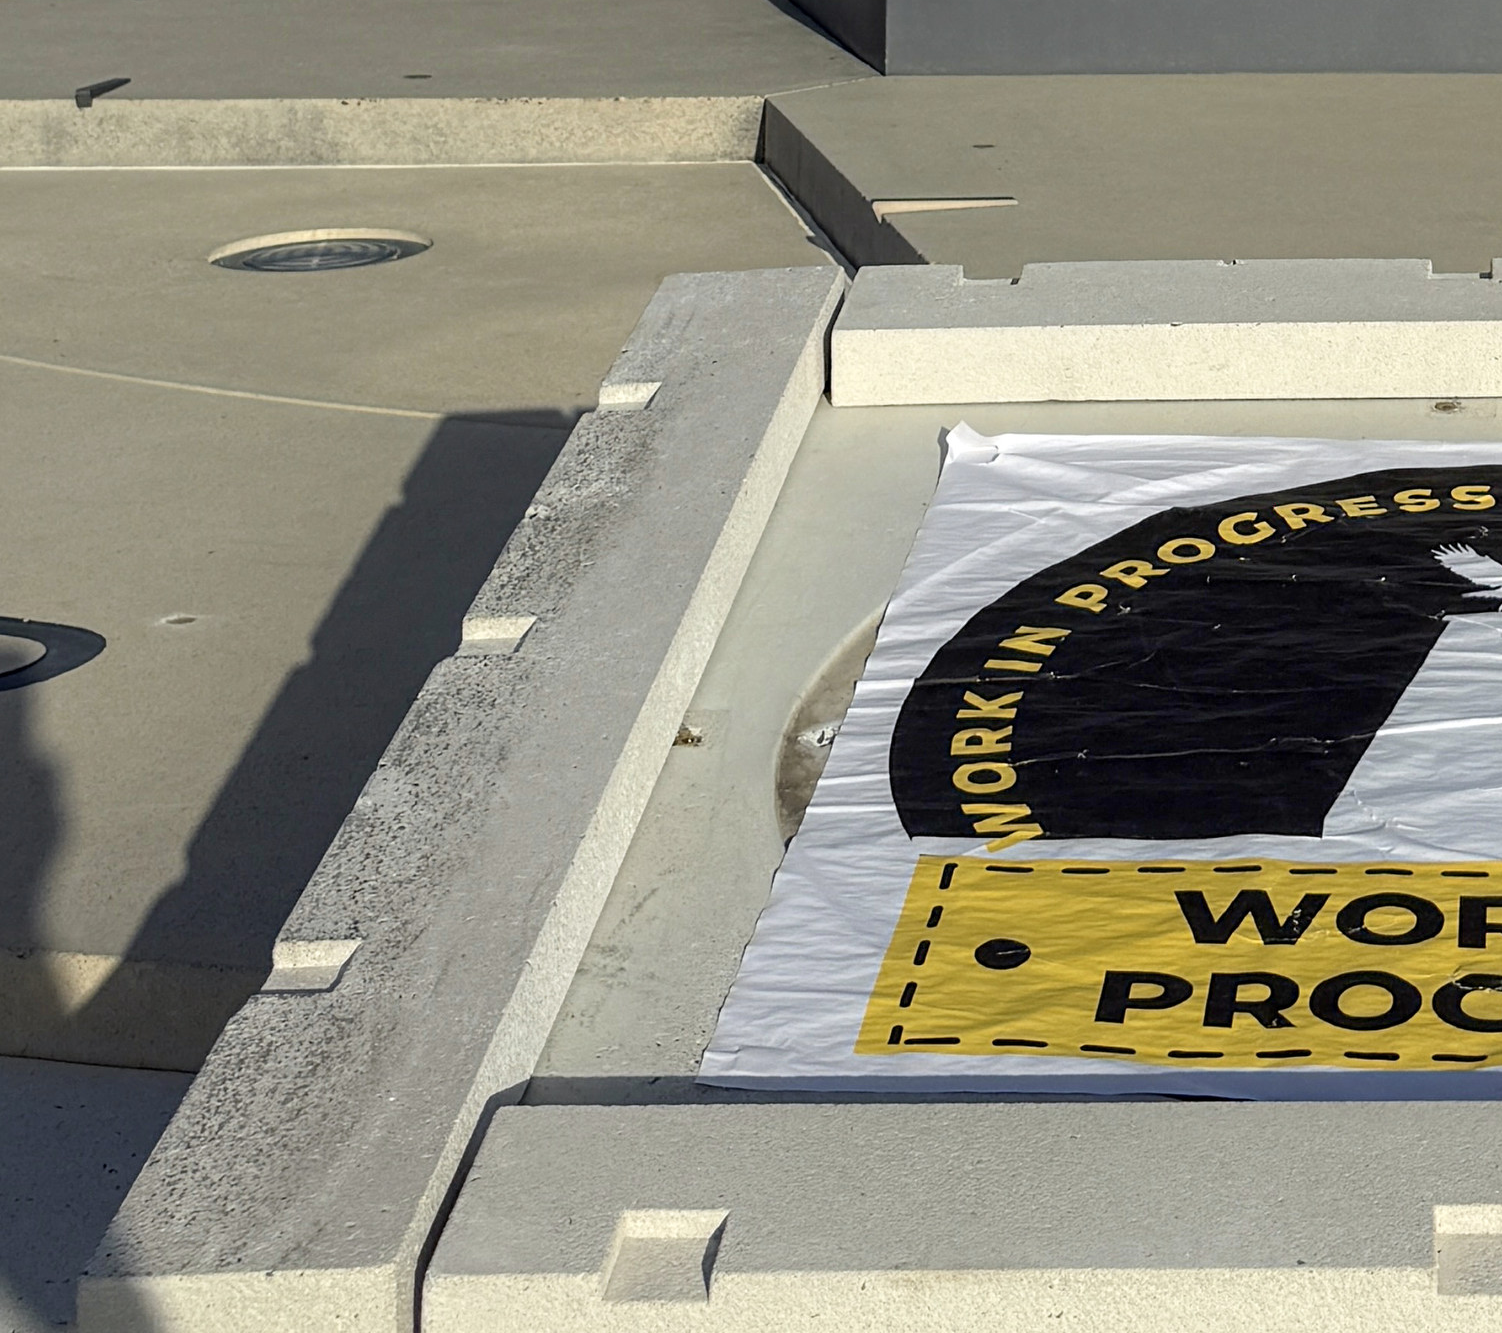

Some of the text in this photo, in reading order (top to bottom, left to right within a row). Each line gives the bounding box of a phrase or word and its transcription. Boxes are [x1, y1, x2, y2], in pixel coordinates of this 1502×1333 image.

[1056, 484, 1495, 613] PROGRESS
[983, 625, 1073, 673] IN
[950, 690, 1044, 854] WORK
